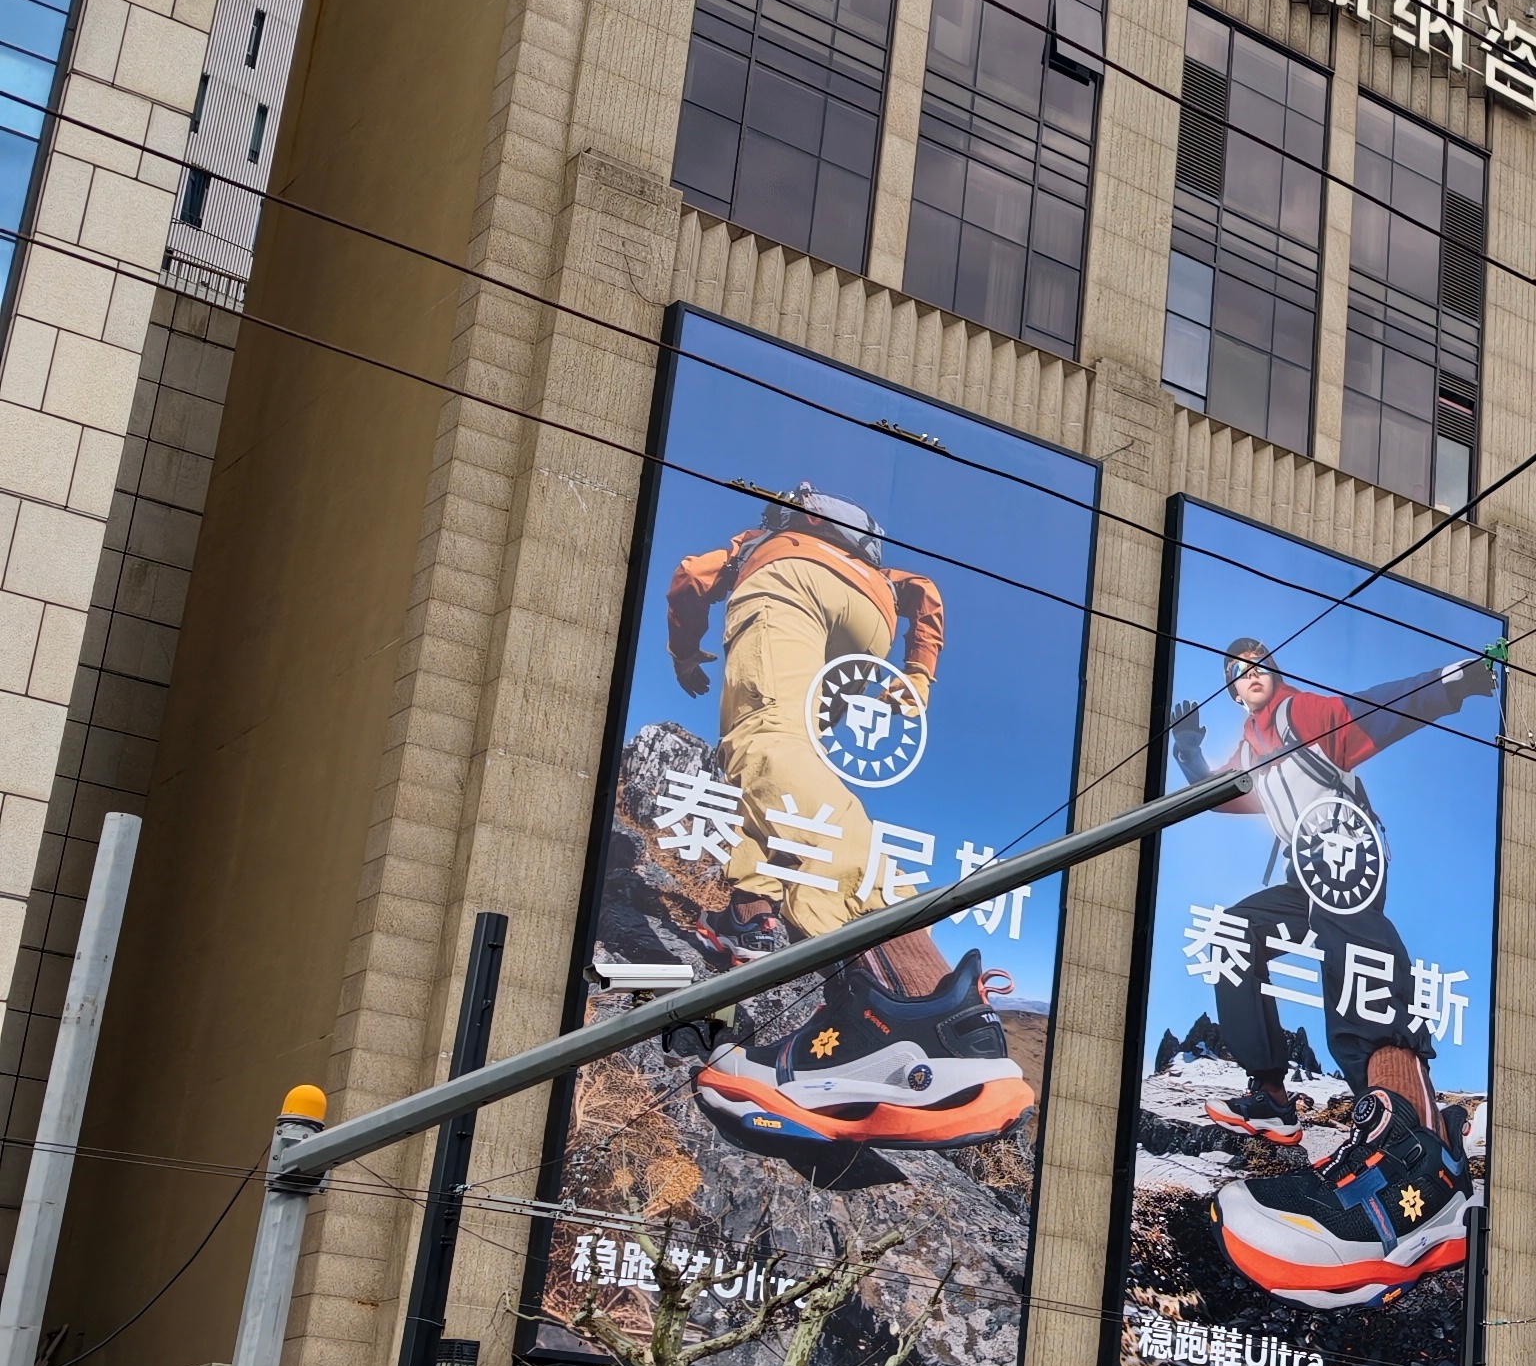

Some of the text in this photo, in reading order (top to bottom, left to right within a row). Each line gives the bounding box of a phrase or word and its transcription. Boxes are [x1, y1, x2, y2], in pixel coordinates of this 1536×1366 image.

[653, 768, 1033, 942] 泰兰尼斯
[1181, 903, 1471, 1047] 泰兰尼斯
